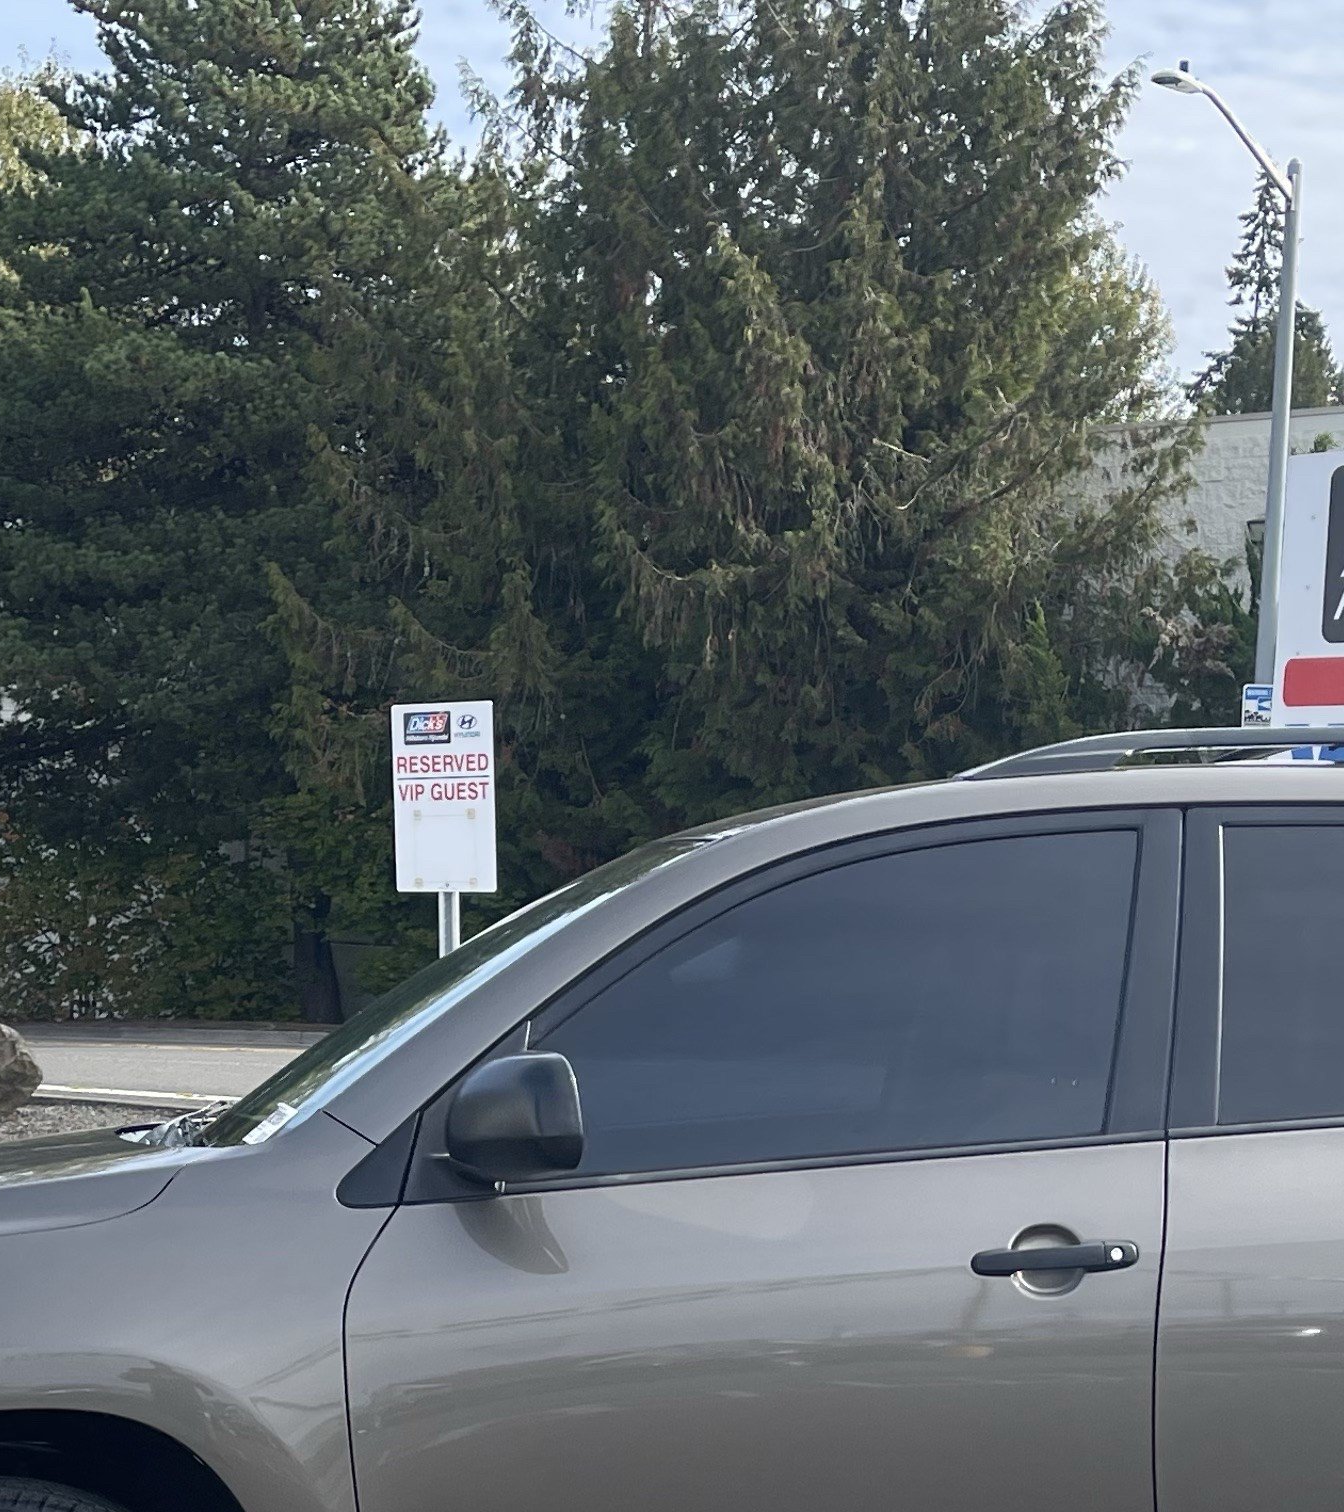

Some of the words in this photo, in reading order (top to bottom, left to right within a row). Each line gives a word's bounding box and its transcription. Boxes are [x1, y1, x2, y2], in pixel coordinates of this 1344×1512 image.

[397, 753, 489, 774] RESERVED
[398, 784, 425, 801] VIP
[431, 782, 489, 801] GUEST
